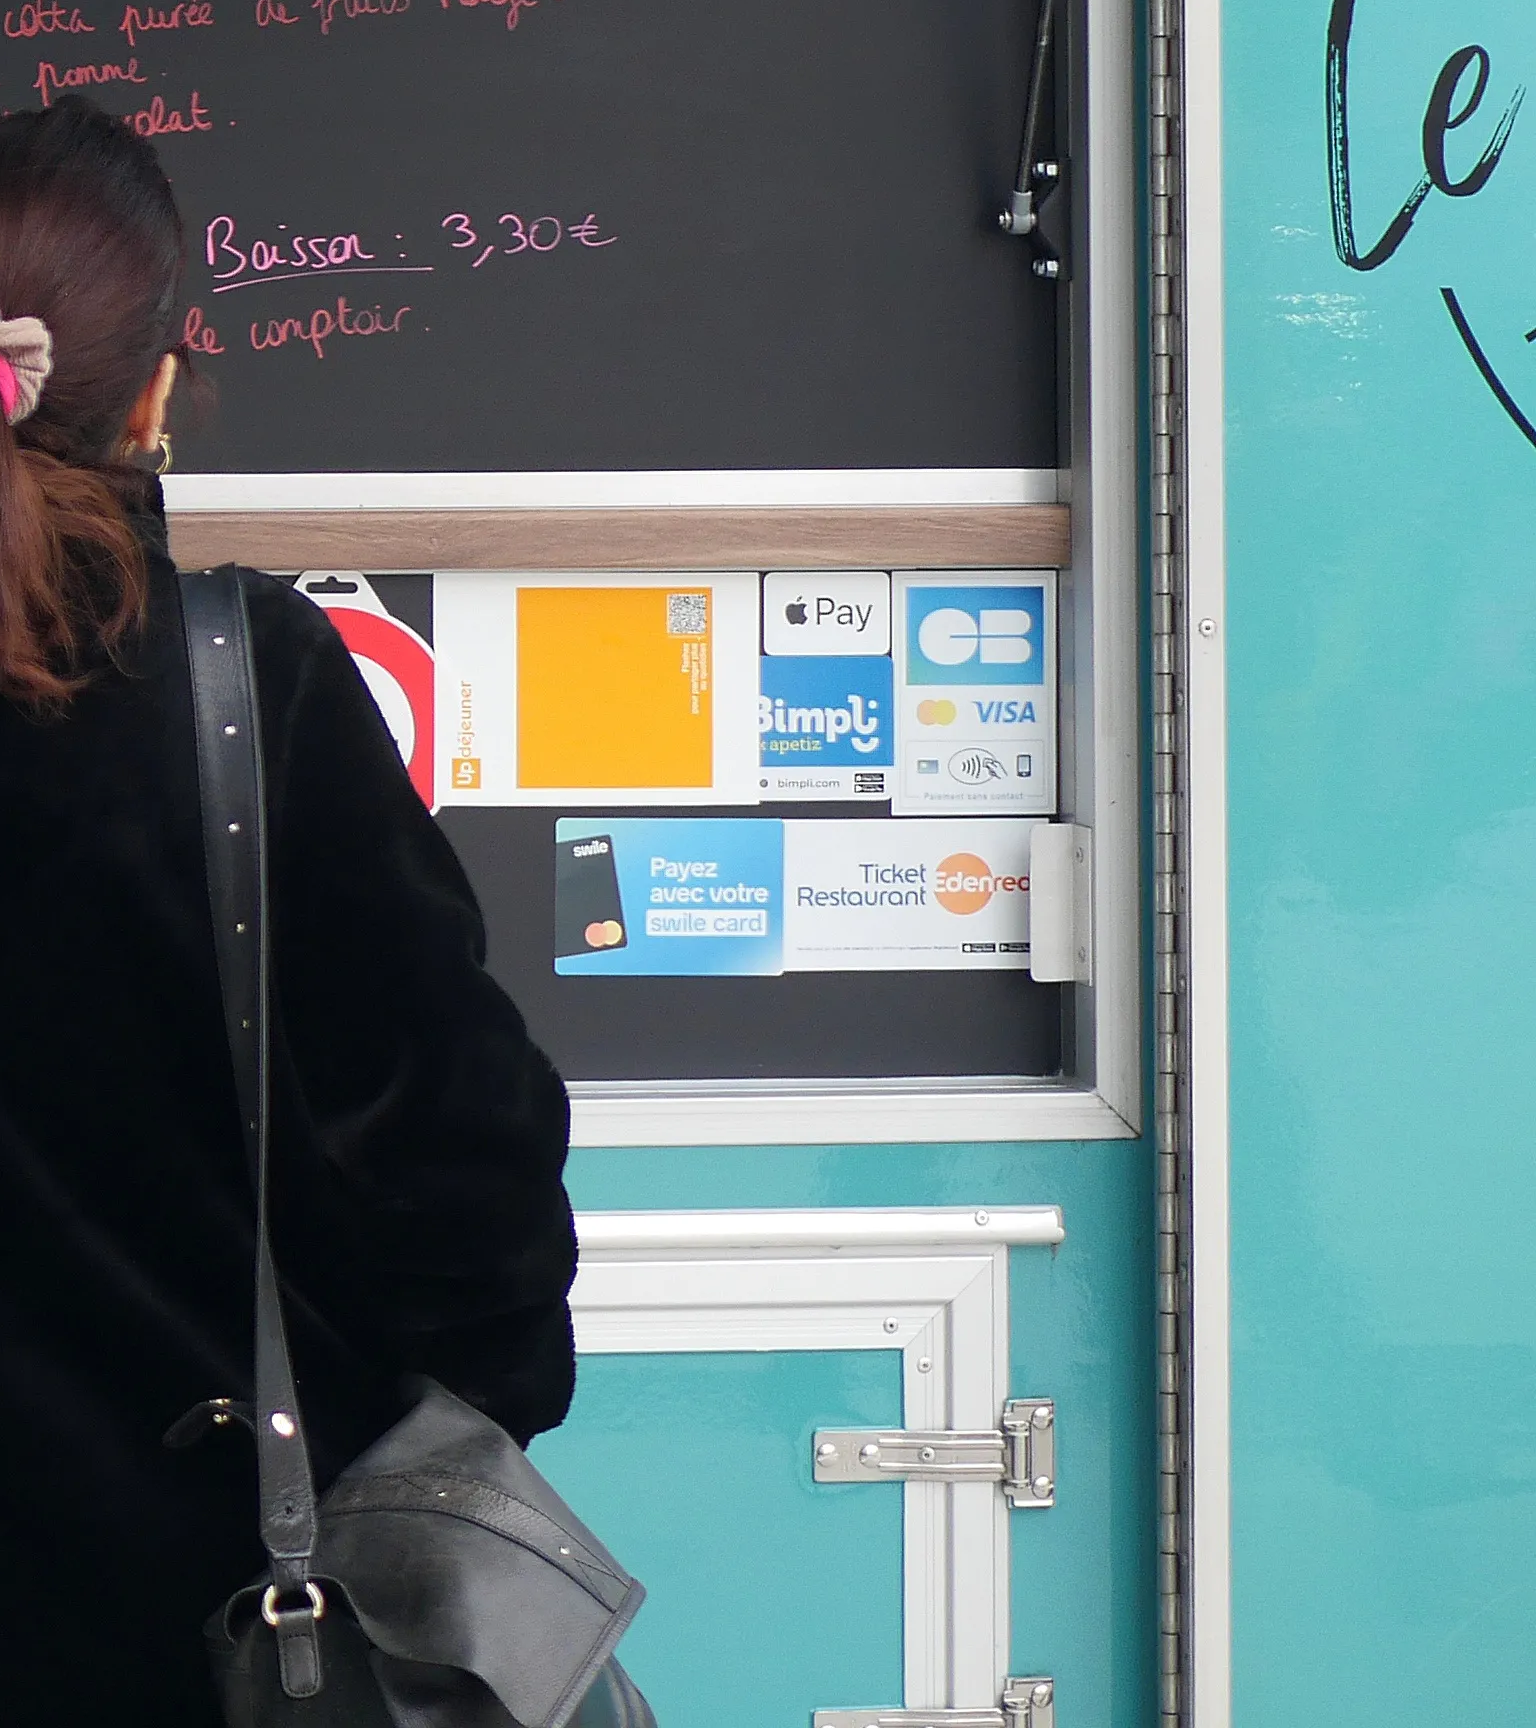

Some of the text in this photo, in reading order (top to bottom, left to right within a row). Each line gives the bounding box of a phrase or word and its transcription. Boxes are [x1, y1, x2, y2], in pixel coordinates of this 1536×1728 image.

[816, 597, 873, 632] Pay
[460, 679, 474, 758] déjeuner
[973, 700, 1036, 723] VISA
[777, 778, 840, 791] bimpli.com
[573, 839, 609, 858] swile
[650, 857, 718, 881] Payez
[859, 863, 927, 884] Ticket
[650, 883, 769, 904] avec votre
[797, 886, 927, 907] Restaurant
[650, 912, 762, 934] swile card
